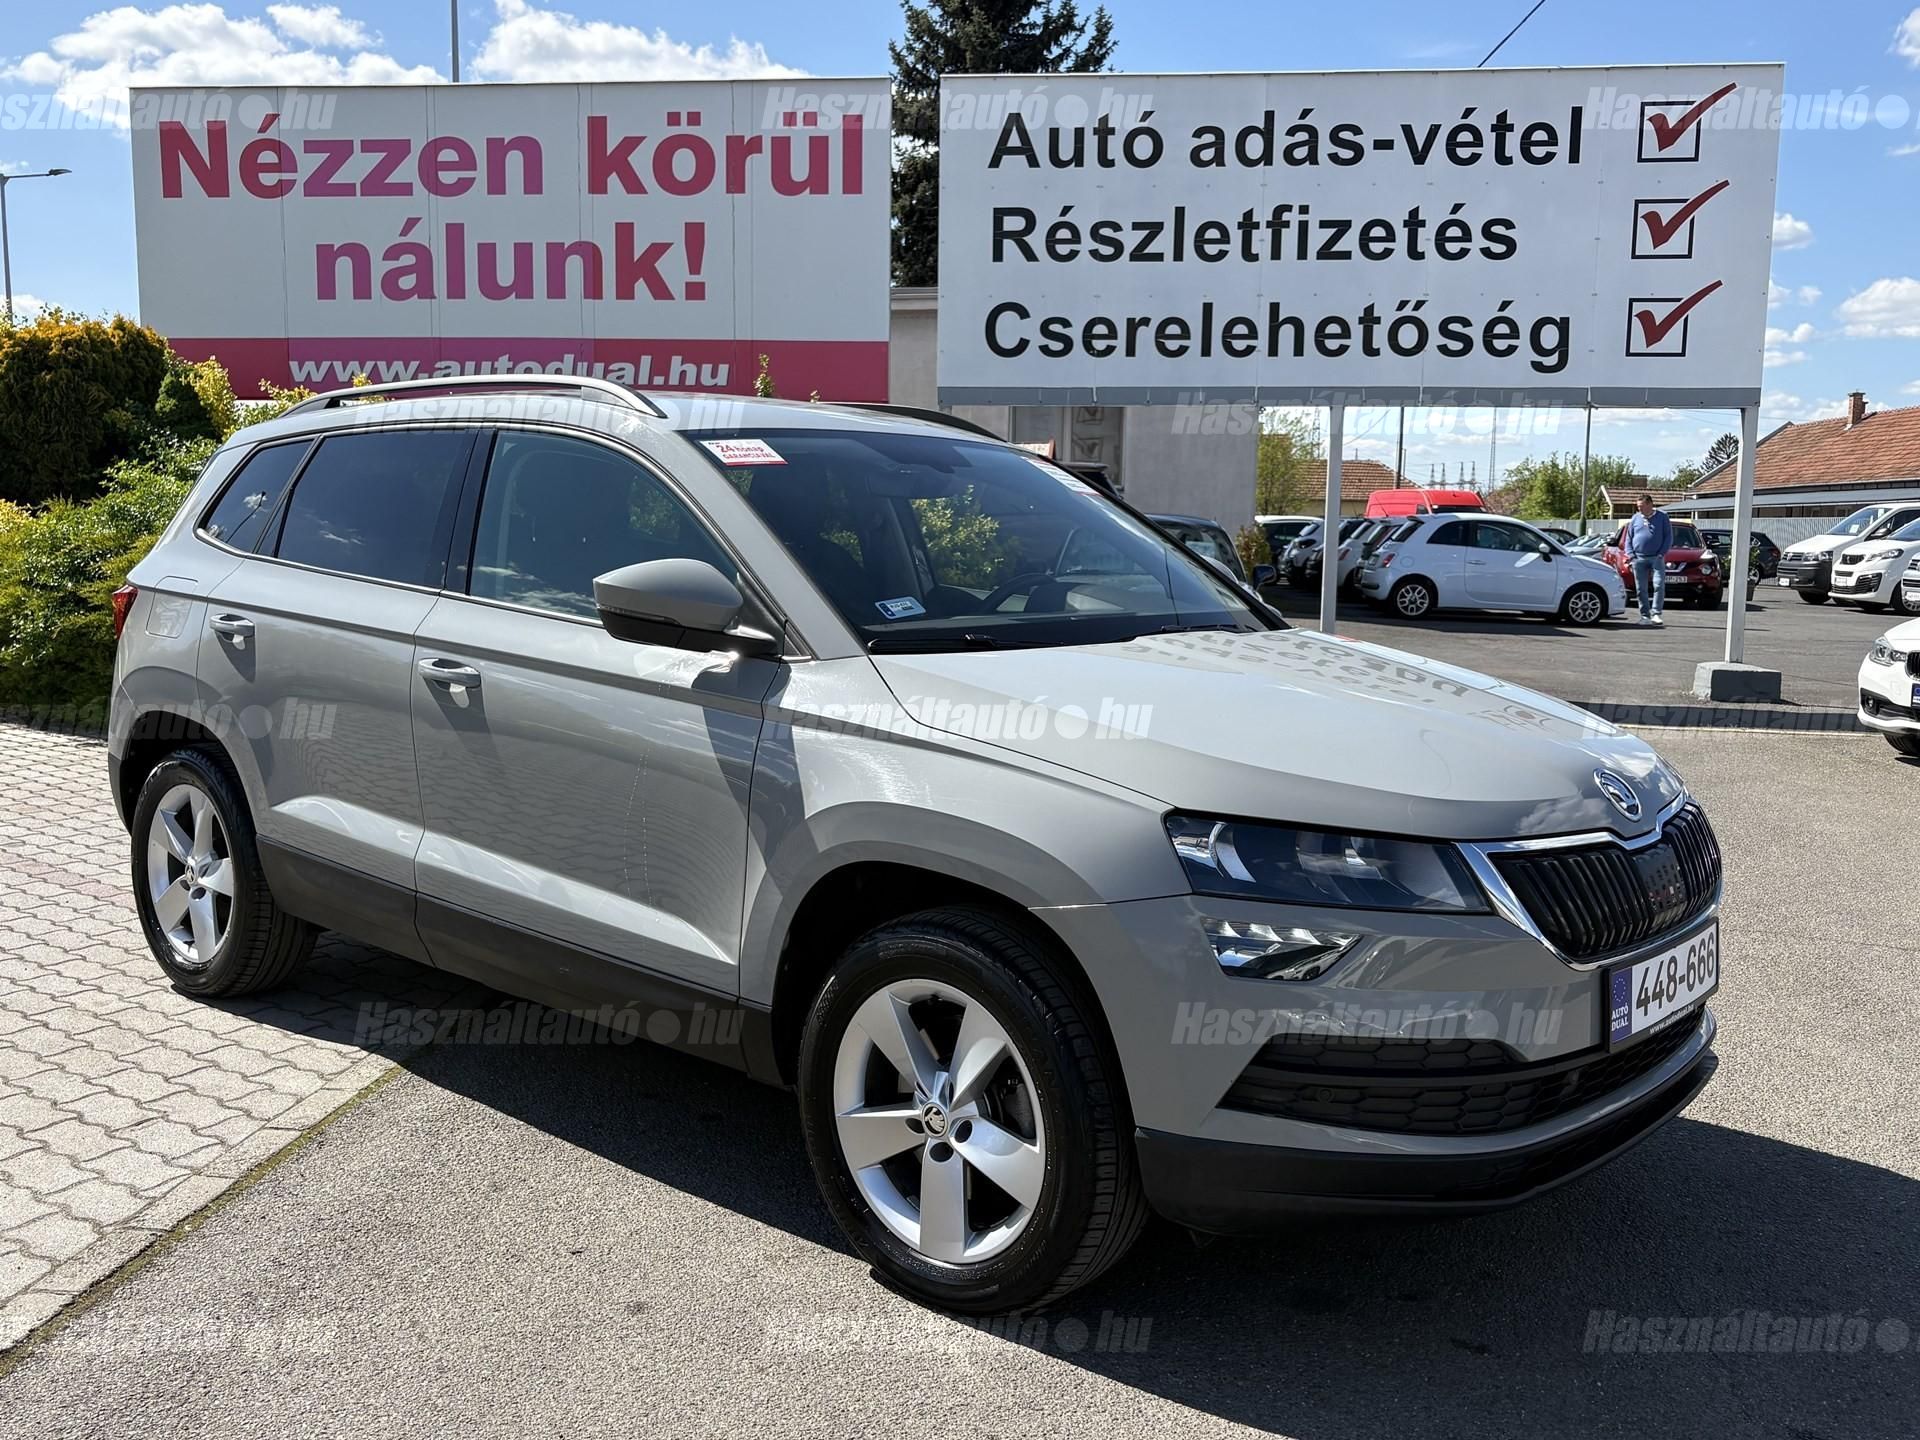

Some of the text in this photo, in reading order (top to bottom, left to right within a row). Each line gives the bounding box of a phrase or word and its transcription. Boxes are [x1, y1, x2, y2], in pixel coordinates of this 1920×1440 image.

[158, 110, 864, 200] Nézzen körül
[987, 106, 1584, 169] Autó adás-vétel
[315, 216, 708, 302] nálunk!
[991, 203, 1519, 264] Részletfizetés
[984, 300, 1572, 374] Cserelehetőség
[1635, 931, 1715, 1016] 448-666
[1611, 1003, 1629, 1020] AUTÓ
[1611, 1016, 1629, 1032] DUAL
